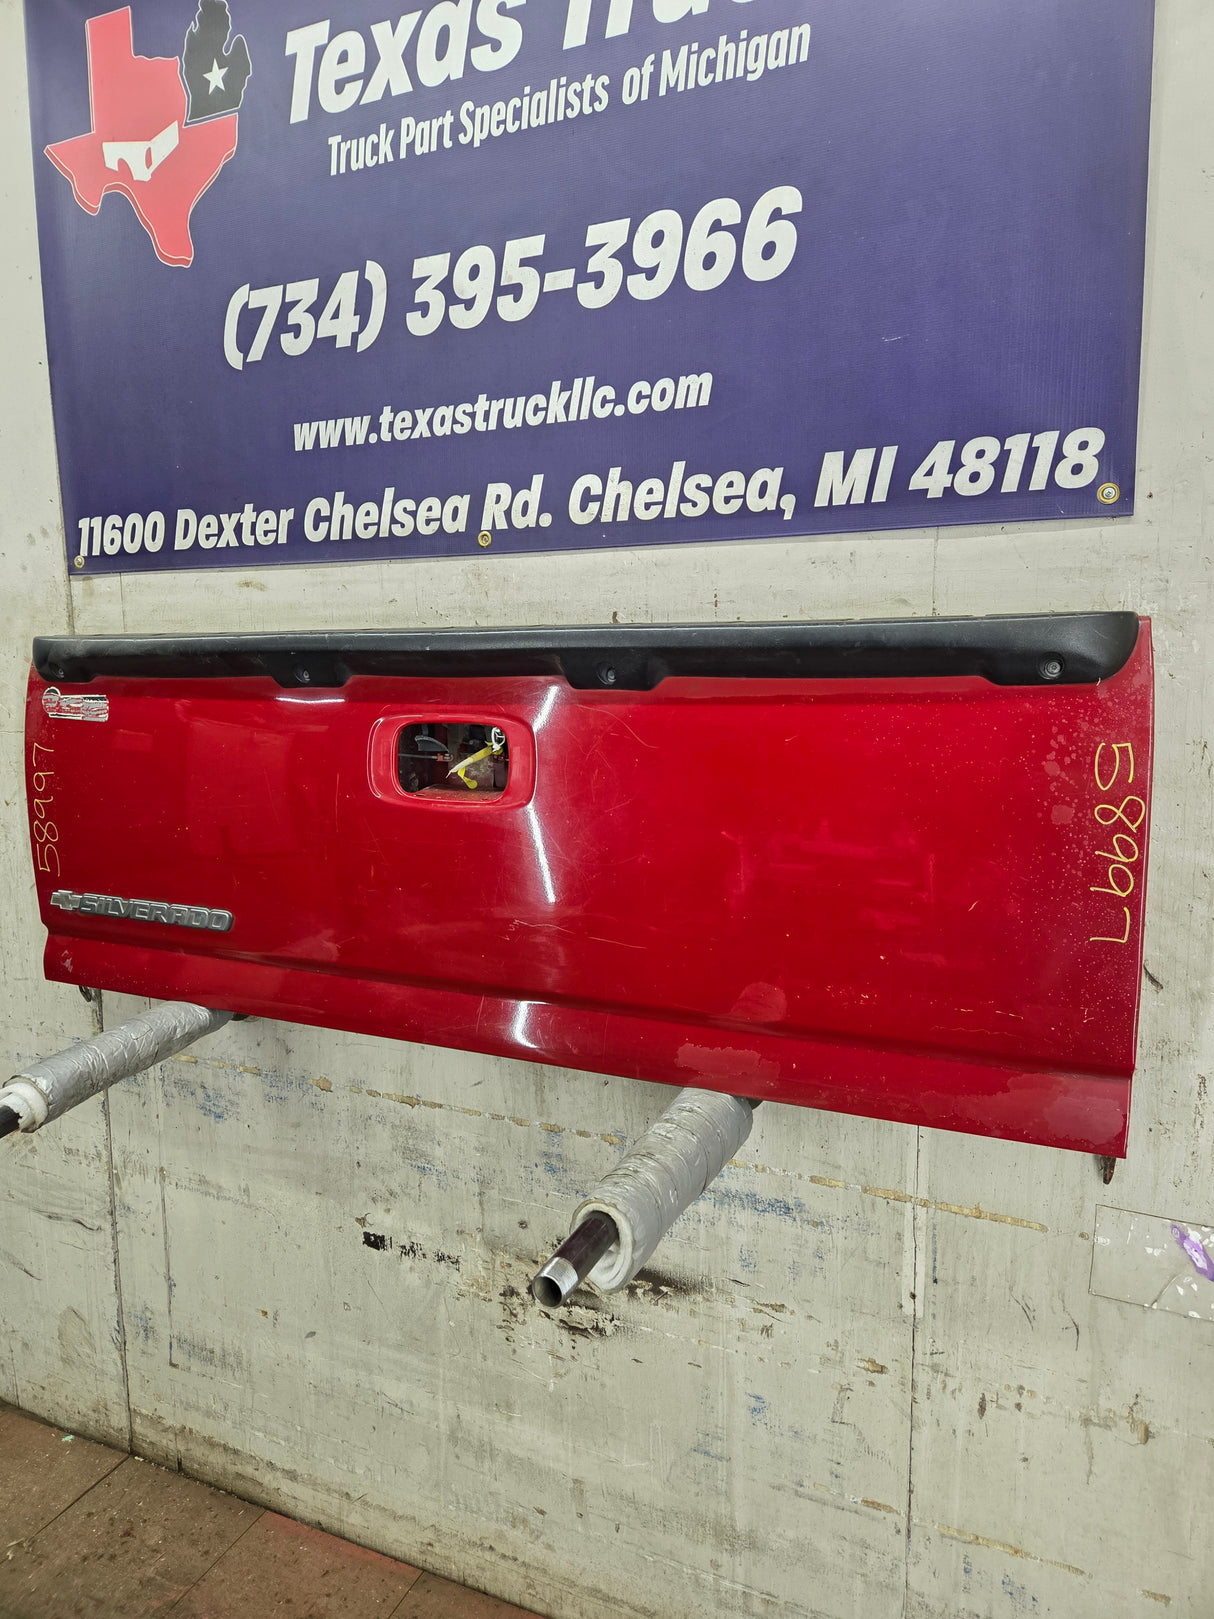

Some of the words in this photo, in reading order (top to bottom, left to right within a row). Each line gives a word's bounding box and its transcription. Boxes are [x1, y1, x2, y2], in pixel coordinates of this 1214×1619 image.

[284, 0, 526, 124] Texas
[327, 124, 395, 176] Truck
[399, 112, 454, 159] Part
[458, 73, 610, 148] Specialists
[621, 53, 655, 105] of
[659, 23, 812, 96] Michigan
[223, 260, 388, 370] (734)
[405, 185, 803, 337] 395-3966
[293, 371, 713, 452] www.texastruckllc.com
[78, 512, 166, 557] 11600
[174, 503, 295, 551] Dexter
[303, 487, 471, 542] Chelsea
[480, 474, 553, 534] Rd.
[568, 460, 797, 525] Chelsea,
[814, 445, 898, 508] MI
[908, 427, 1106, 499] 48118
[32, 742, 60, 876] 58997
[1089, 742, 1146, 943] 58997
[79, 893, 233, 932] SILVERADO
